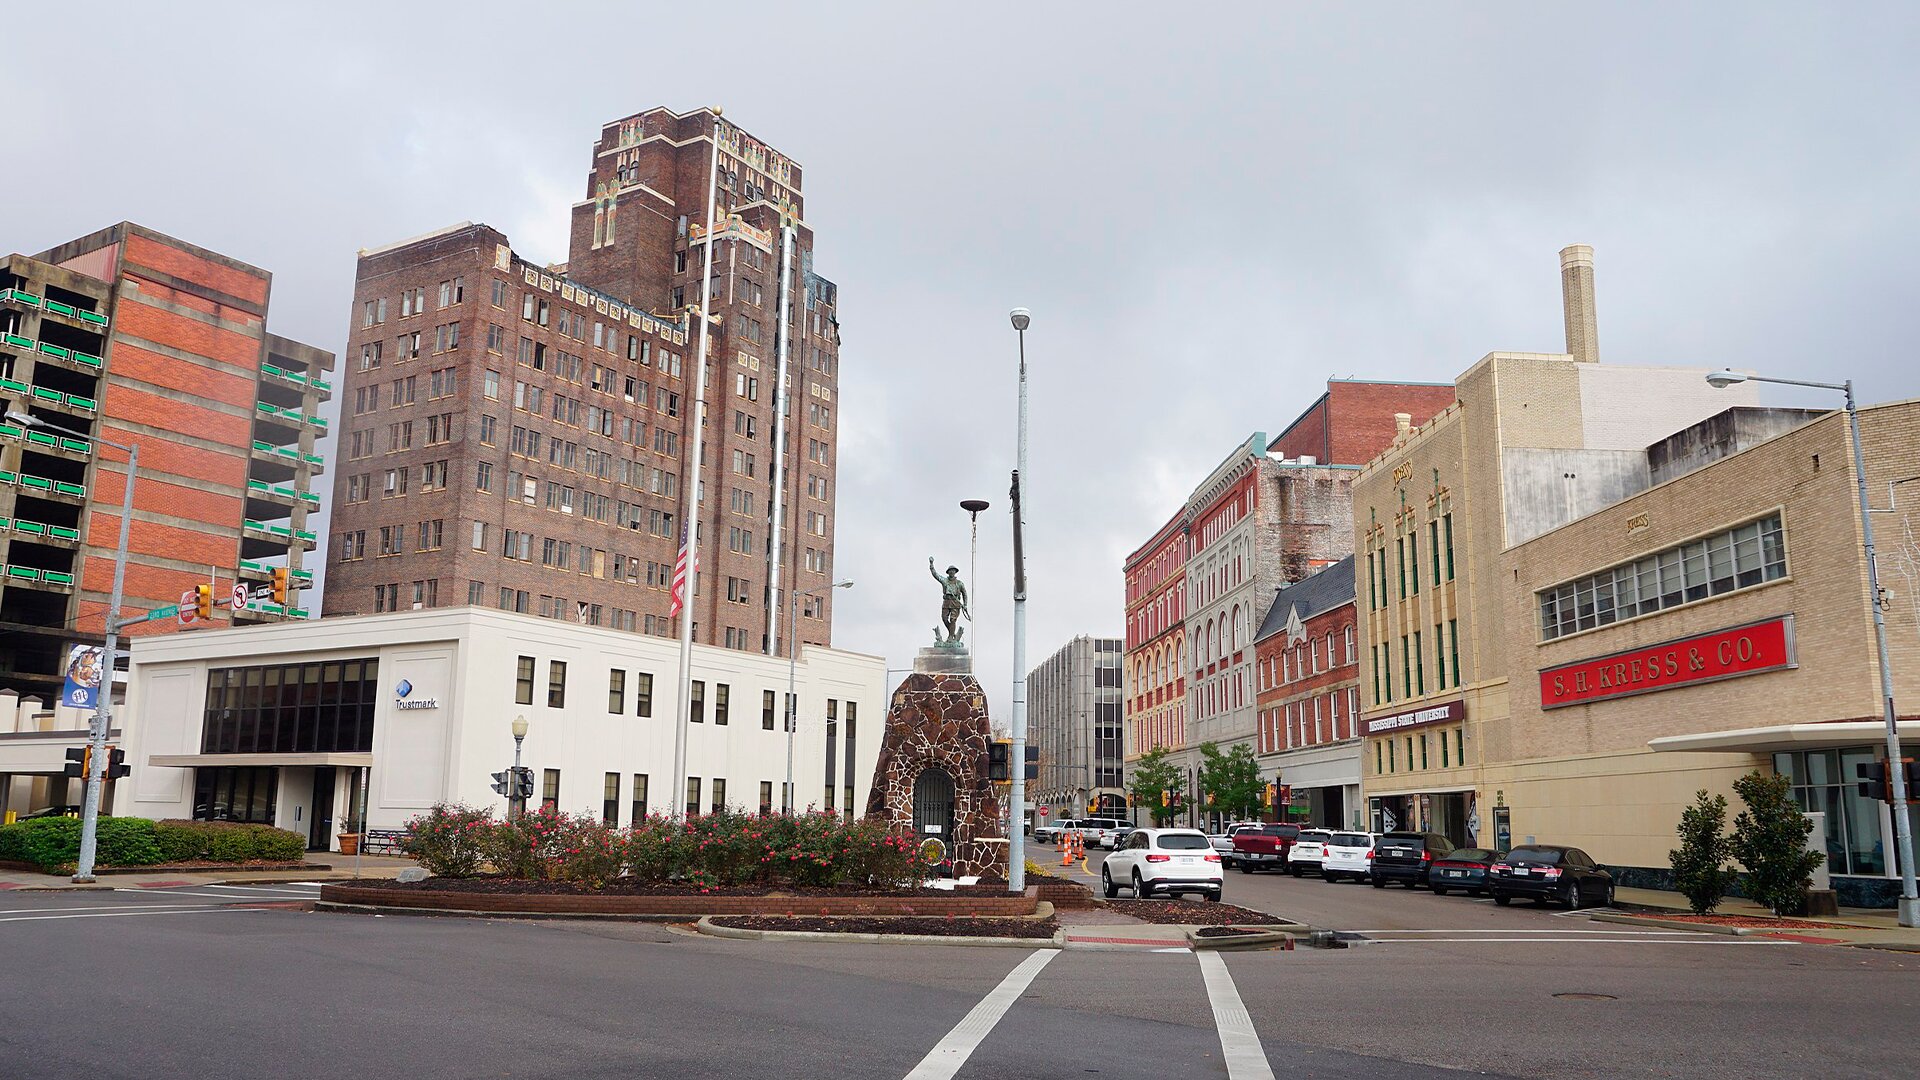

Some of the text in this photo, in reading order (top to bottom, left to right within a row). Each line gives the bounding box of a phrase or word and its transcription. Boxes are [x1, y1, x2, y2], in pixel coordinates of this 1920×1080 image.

[1553, 636, 1762, 697] S. H. KRESS & CO.
[395, 698, 437, 710] Trustmark
[1369, 705, 1450, 732] MISSISSIPPI STATE UNIVERSITY
